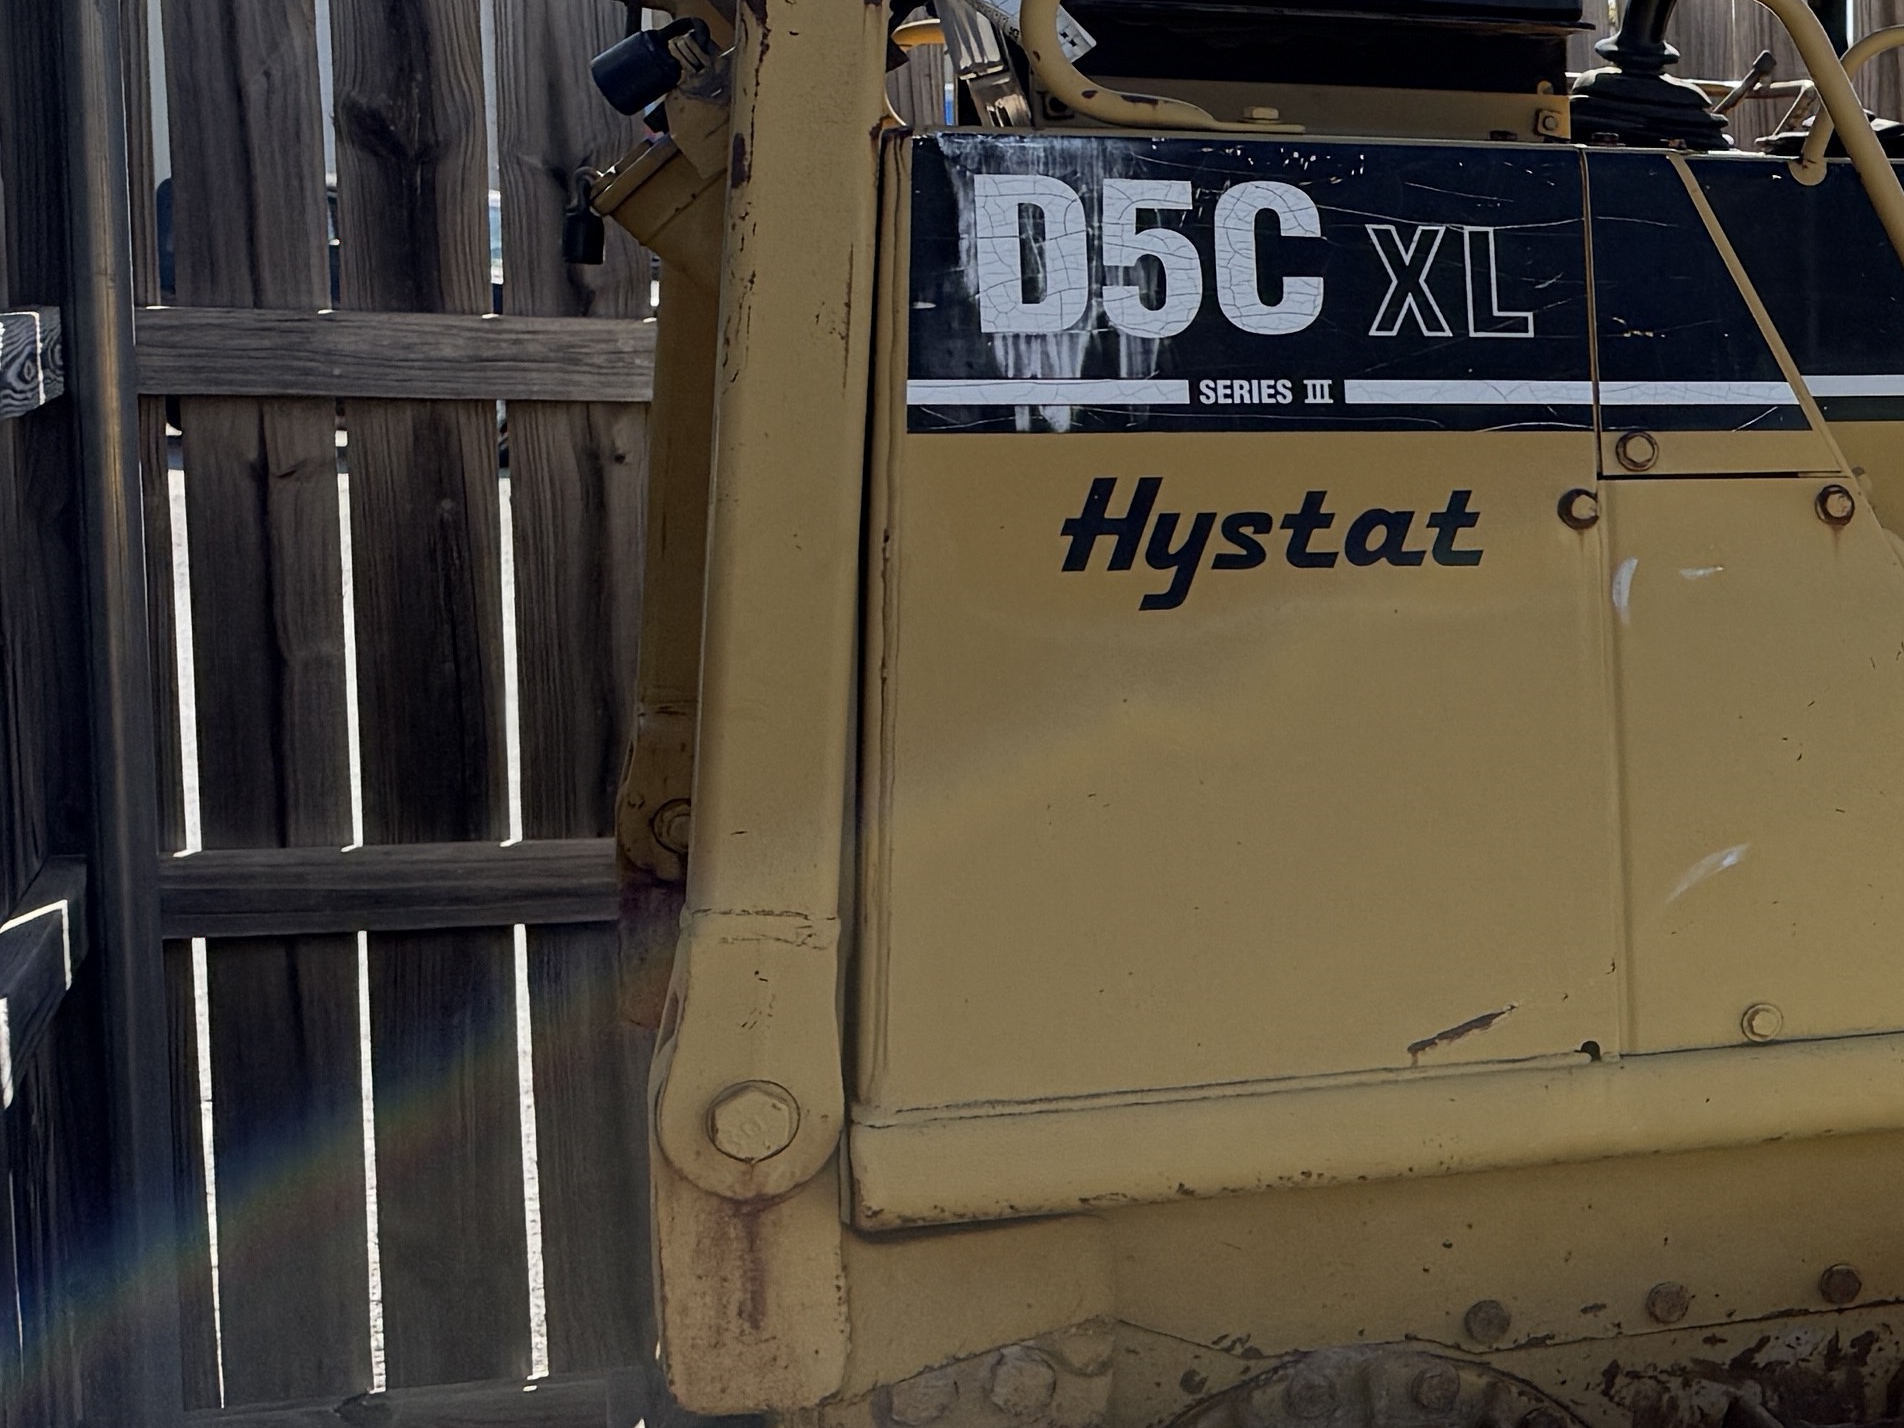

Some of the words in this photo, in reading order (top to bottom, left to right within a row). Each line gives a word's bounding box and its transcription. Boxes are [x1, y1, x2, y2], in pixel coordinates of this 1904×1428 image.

[973, 173, 1325, 338] D5C
[1366, 223, 1536, 338] XL
[1199, 379, 1293, 405] SERIES
[1302, 379, 1334, 404] III
[1060, 475, 1485, 612] Hystat
